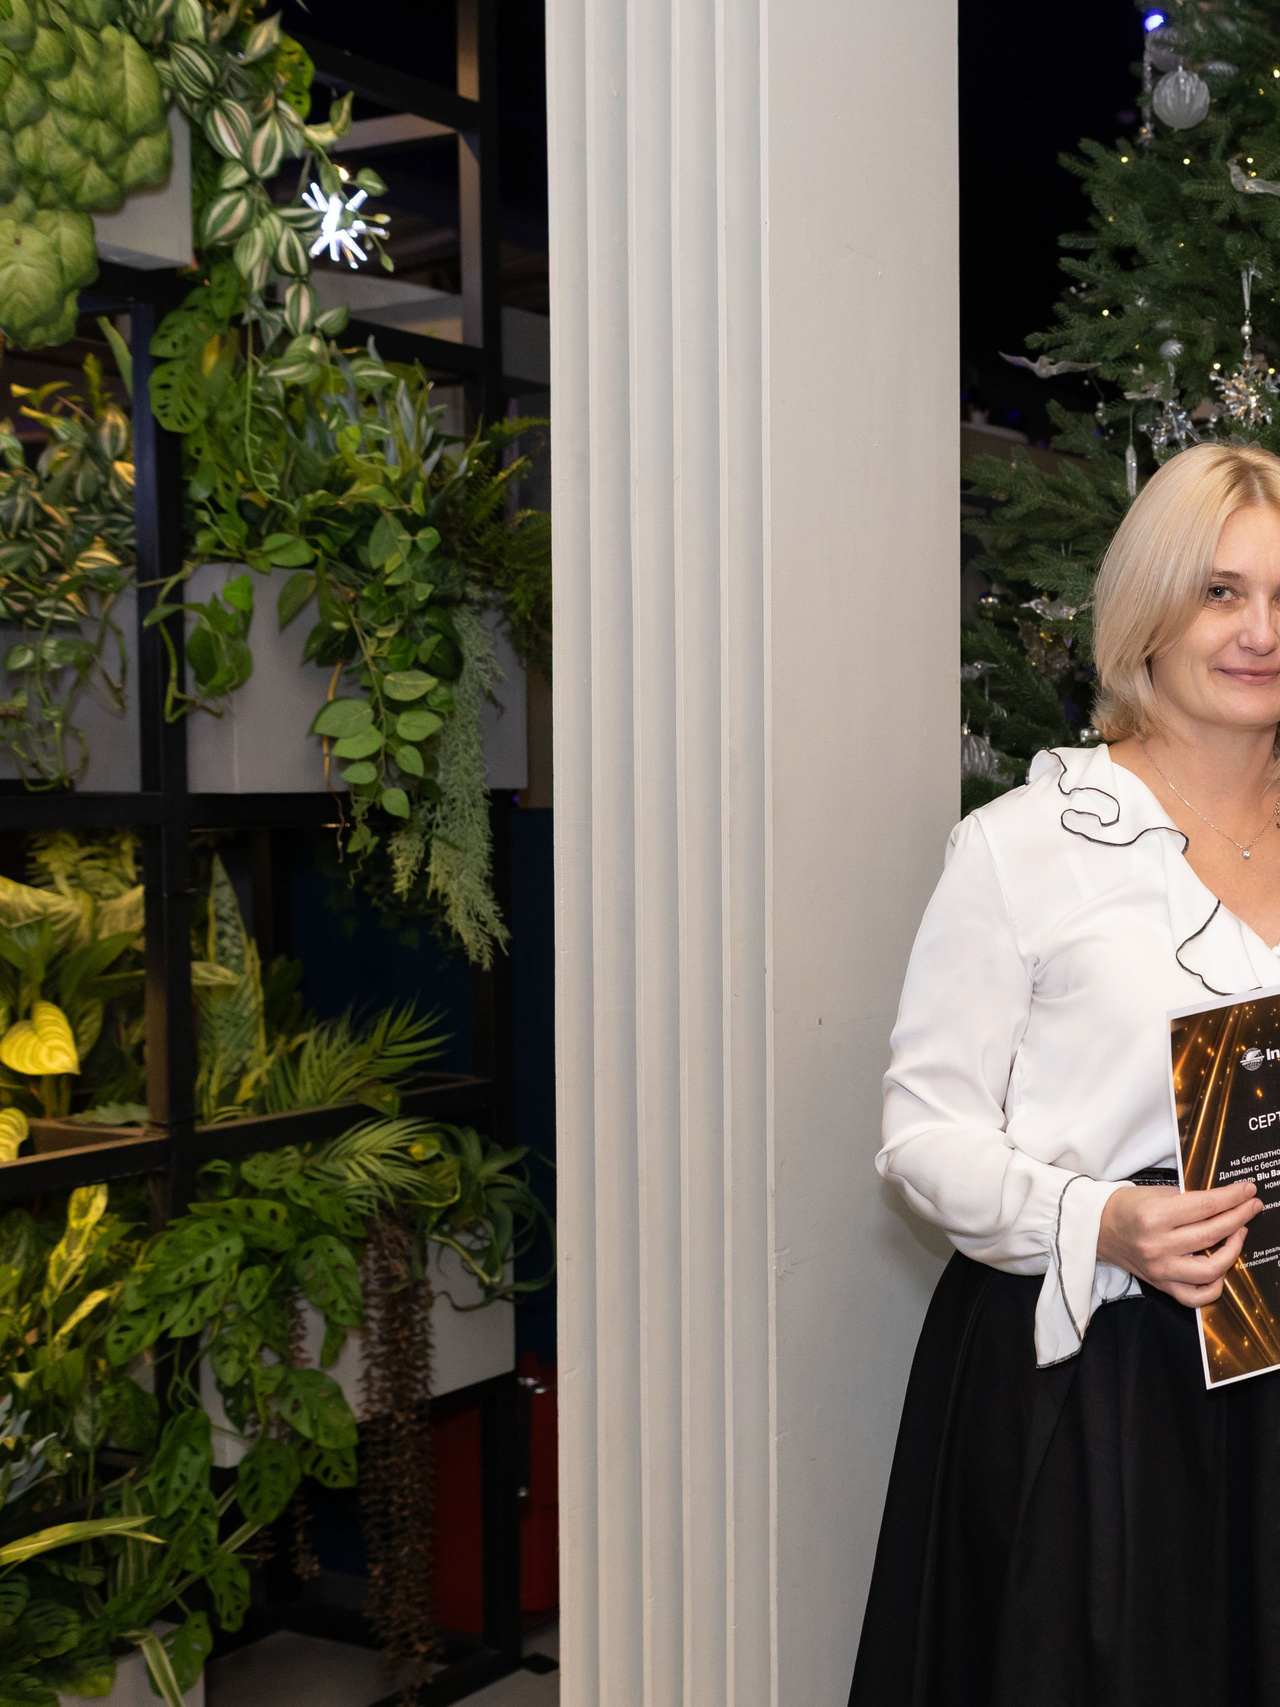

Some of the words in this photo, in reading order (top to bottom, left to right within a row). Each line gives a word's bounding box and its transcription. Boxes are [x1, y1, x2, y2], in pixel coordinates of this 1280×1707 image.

[1230, 1158, 1240, 1167] на
[1219, 1166, 1253, 1181] Даламан
[1256, 1172, 1270, 1182] Blu
[1253, 1250, 1264, 1259] Для
